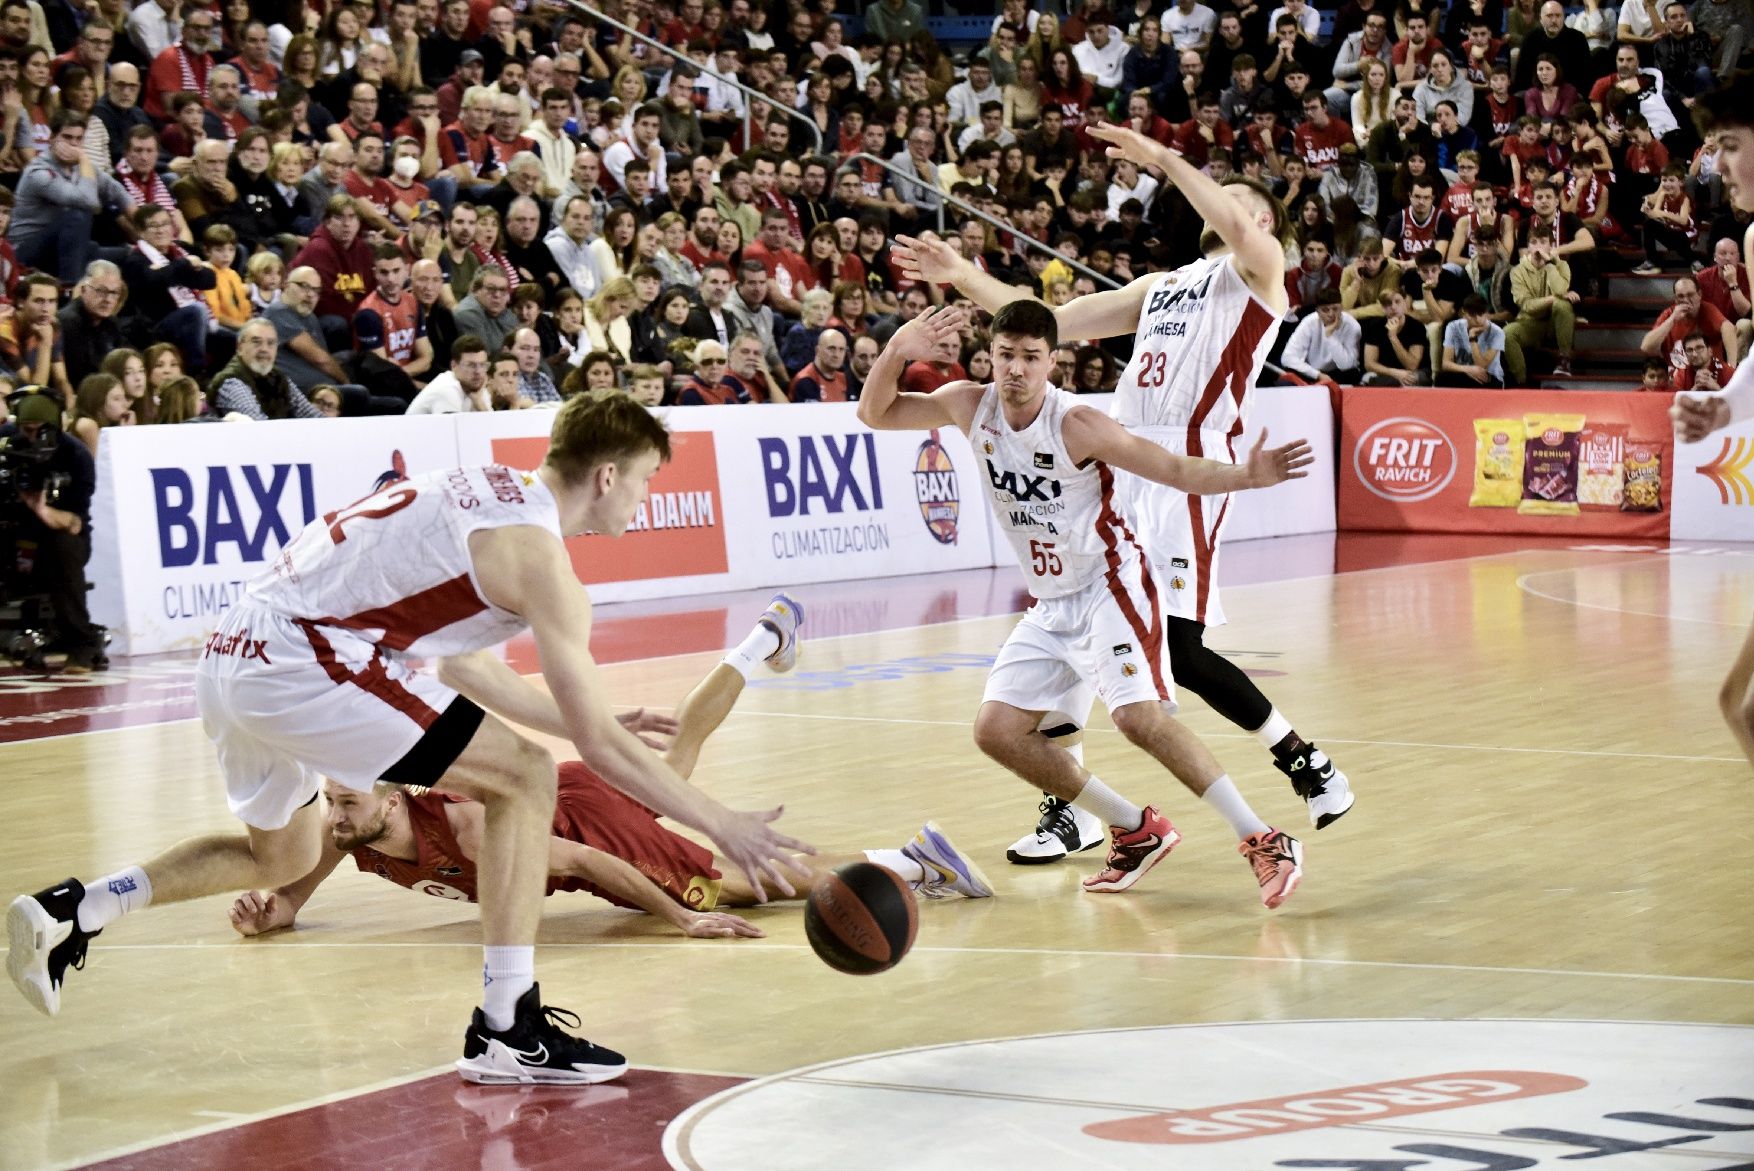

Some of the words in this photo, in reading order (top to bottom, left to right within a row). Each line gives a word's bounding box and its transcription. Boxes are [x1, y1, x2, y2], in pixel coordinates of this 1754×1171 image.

[1307, 147, 1339, 163] BAXI
[1144, 321, 1186, 341] RESA
[1137, 351, 1167, 387] 23
[1369, 437, 1443, 467] FRIT
[1532, 449, 1570, 459] PREMIUM
[757, 433, 884, 518] BAXI
[918, 472, 958, 503] BAXI
[1375, 467, 1431, 482] RAVICH
[148, 463, 317, 569] BAXI
[650, 490, 715, 530] DAMM
[771, 517, 890, 559] CLIMATIZACIÓN
[1029, 539, 1063, 577] 55
[163, 581, 246, 620] CLIMAT
[1167, 1077, 1522, 1138] GROUP
